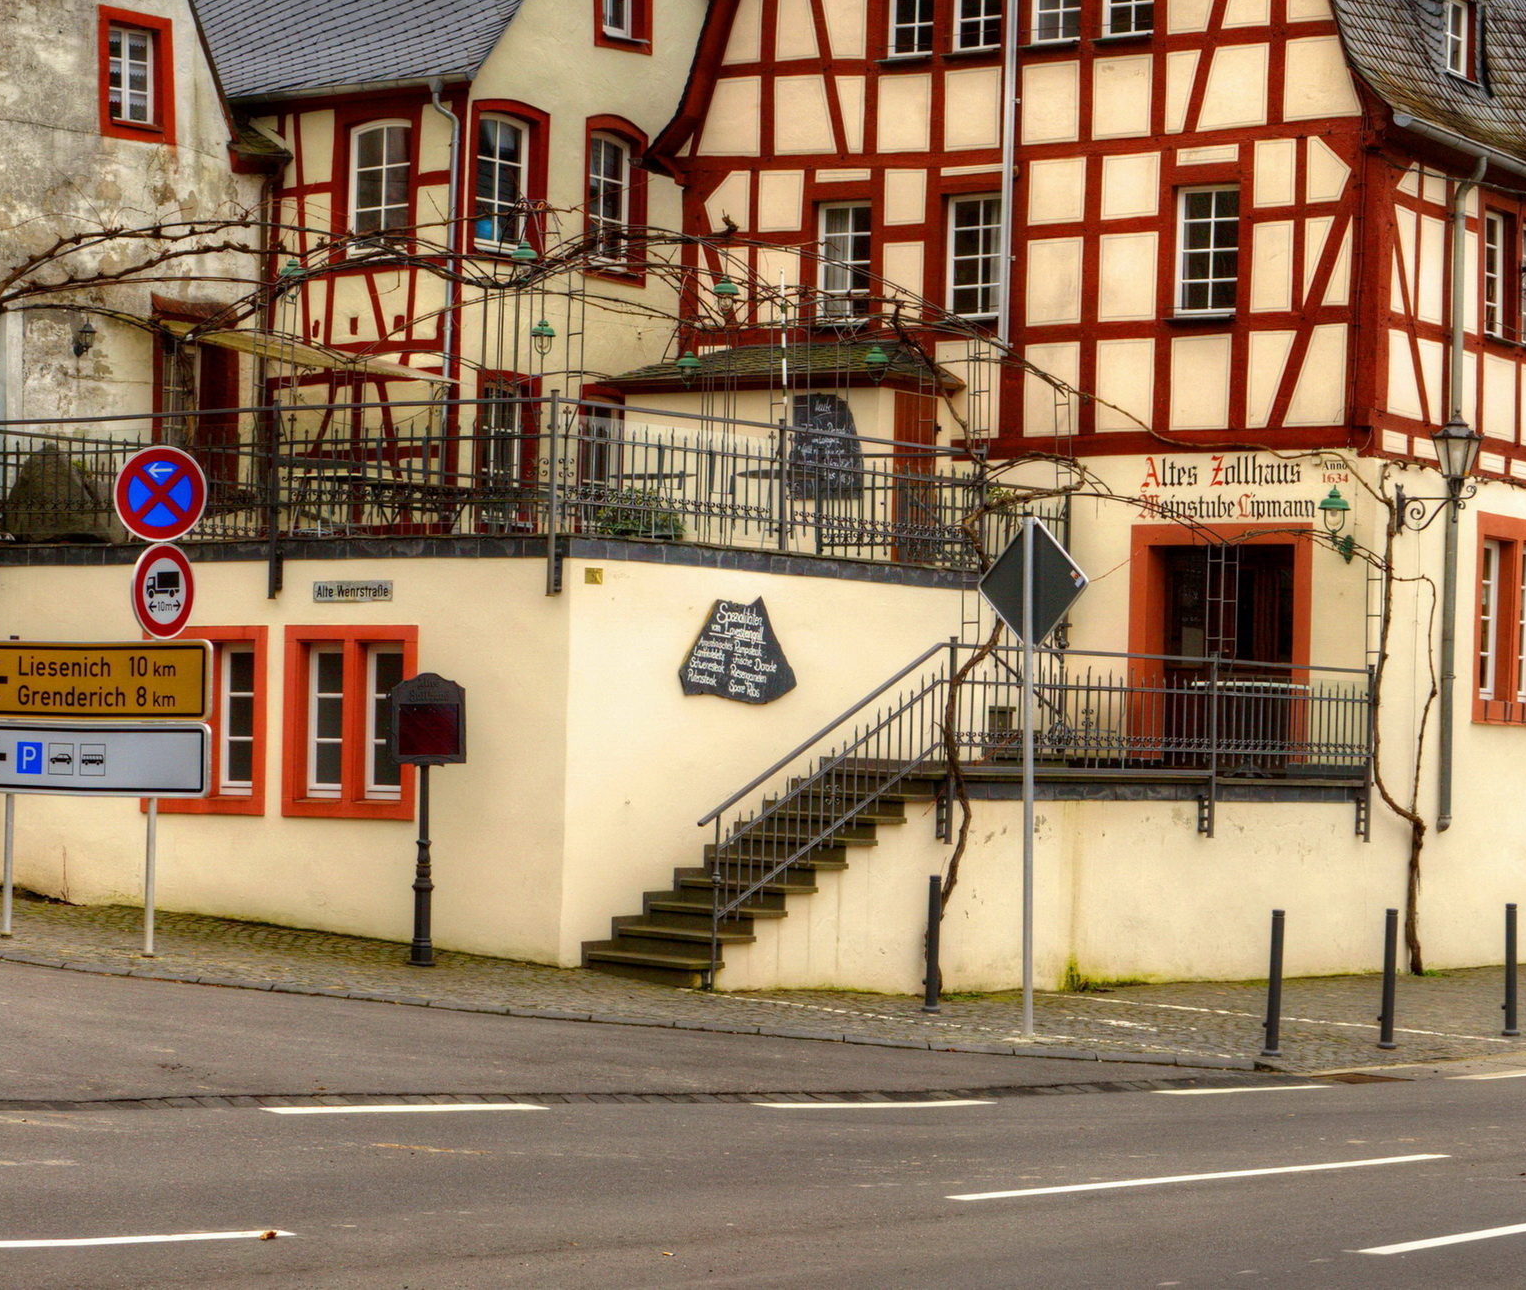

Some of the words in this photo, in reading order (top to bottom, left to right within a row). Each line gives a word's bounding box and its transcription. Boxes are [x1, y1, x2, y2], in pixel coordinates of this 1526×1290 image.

[1140, 456, 1198, 492] Altes
[1209, 454, 1301, 487] Zollhaus
[1323, 461, 1349, 471] Anno
[1322, 473, 1349, 484] 1634
[1137, 494, 1235, 521] Weinstube
[1237, 492, 1316, 521] Lipmann
[316, 585, 334, 598] Alte
[18, 656, 111, 677] Liesenich
[128, 656, 148, 677] 10
[153, 661, 176, 677] km
[18, 685, 126, 707] Grenderich
[136, 686, 147, 707] 8
[152, 691, 176, 707] km
[23, 746, 37, 769] P
